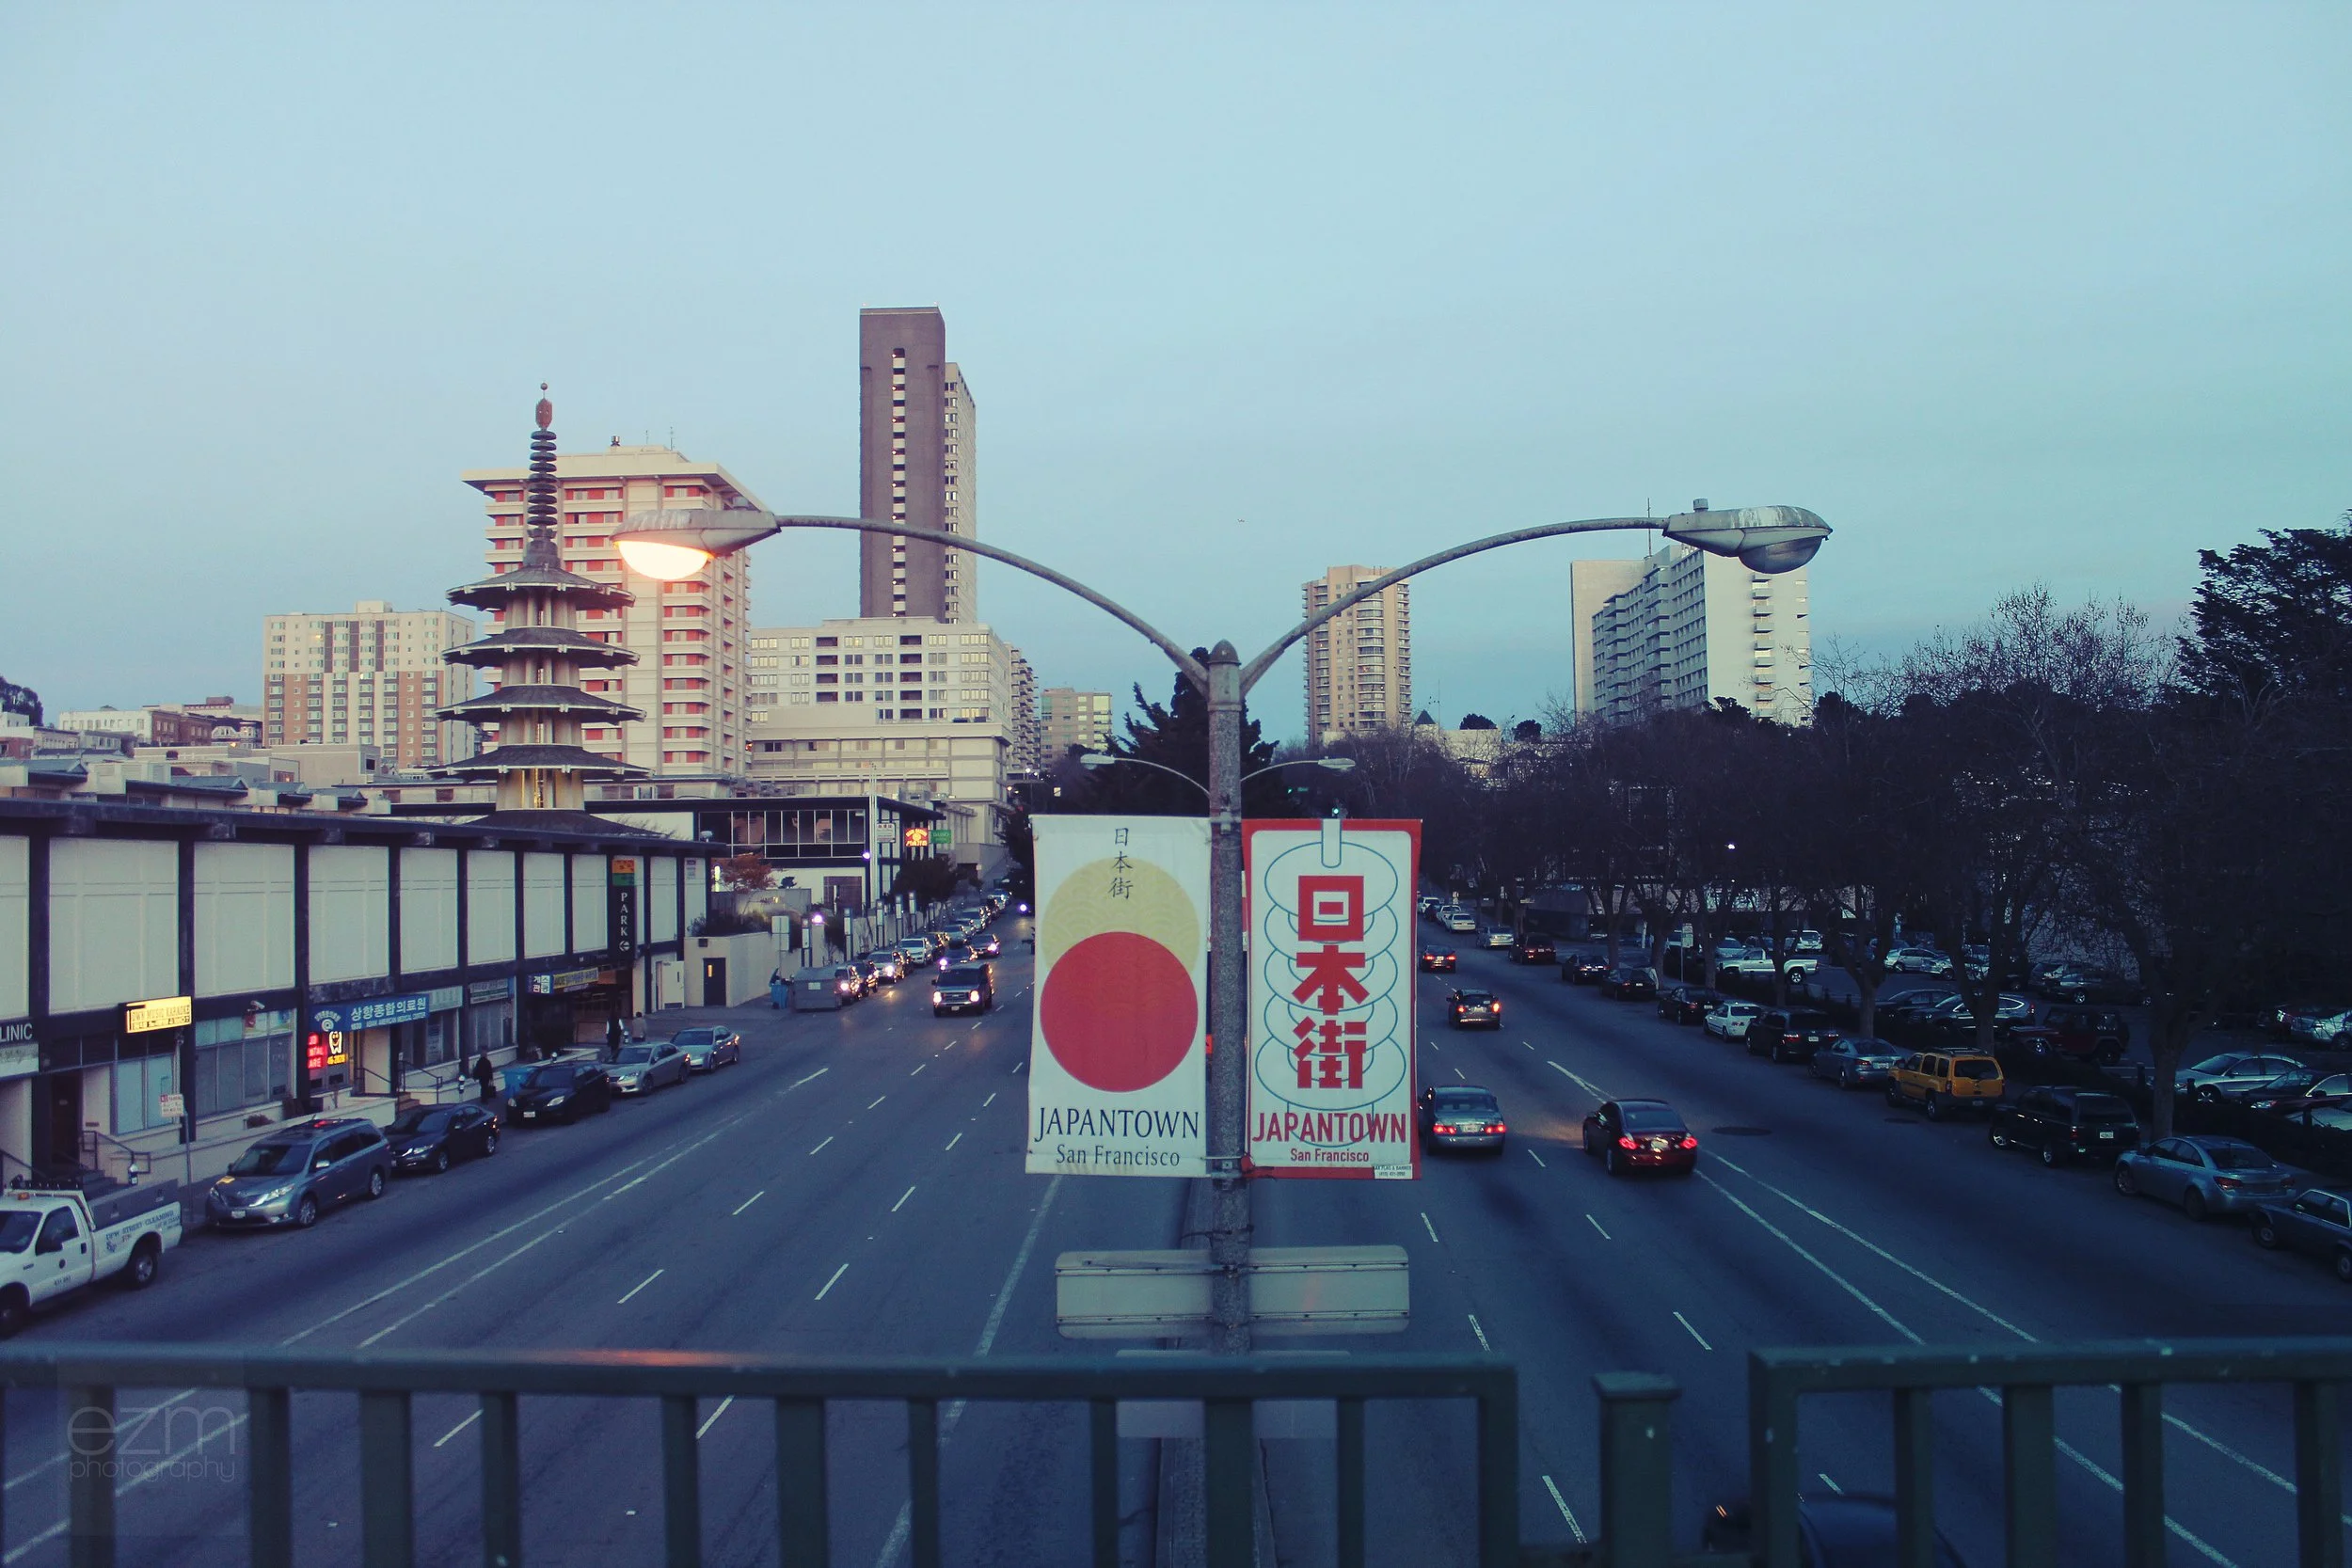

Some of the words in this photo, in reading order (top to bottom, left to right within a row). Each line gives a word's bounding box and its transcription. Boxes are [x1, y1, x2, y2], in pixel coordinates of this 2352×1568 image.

[1107, 828, 1134, 899] 日本街
[620, 892, 628, 937] PARK
[1292, 876, 1370, 1089] 日本街
[1034, 1107, 1200, 1143] JAPANTOWN
[1252, 1112, 1406, 1143] JAPANTOWN
[1056, 1144, 1087, 1164] San
[1094, 1145, 1180, 1167] Francisco
[1290, 1148, 1311, 1162] San
[1314, 1148, 1370, 1163] Francisco
